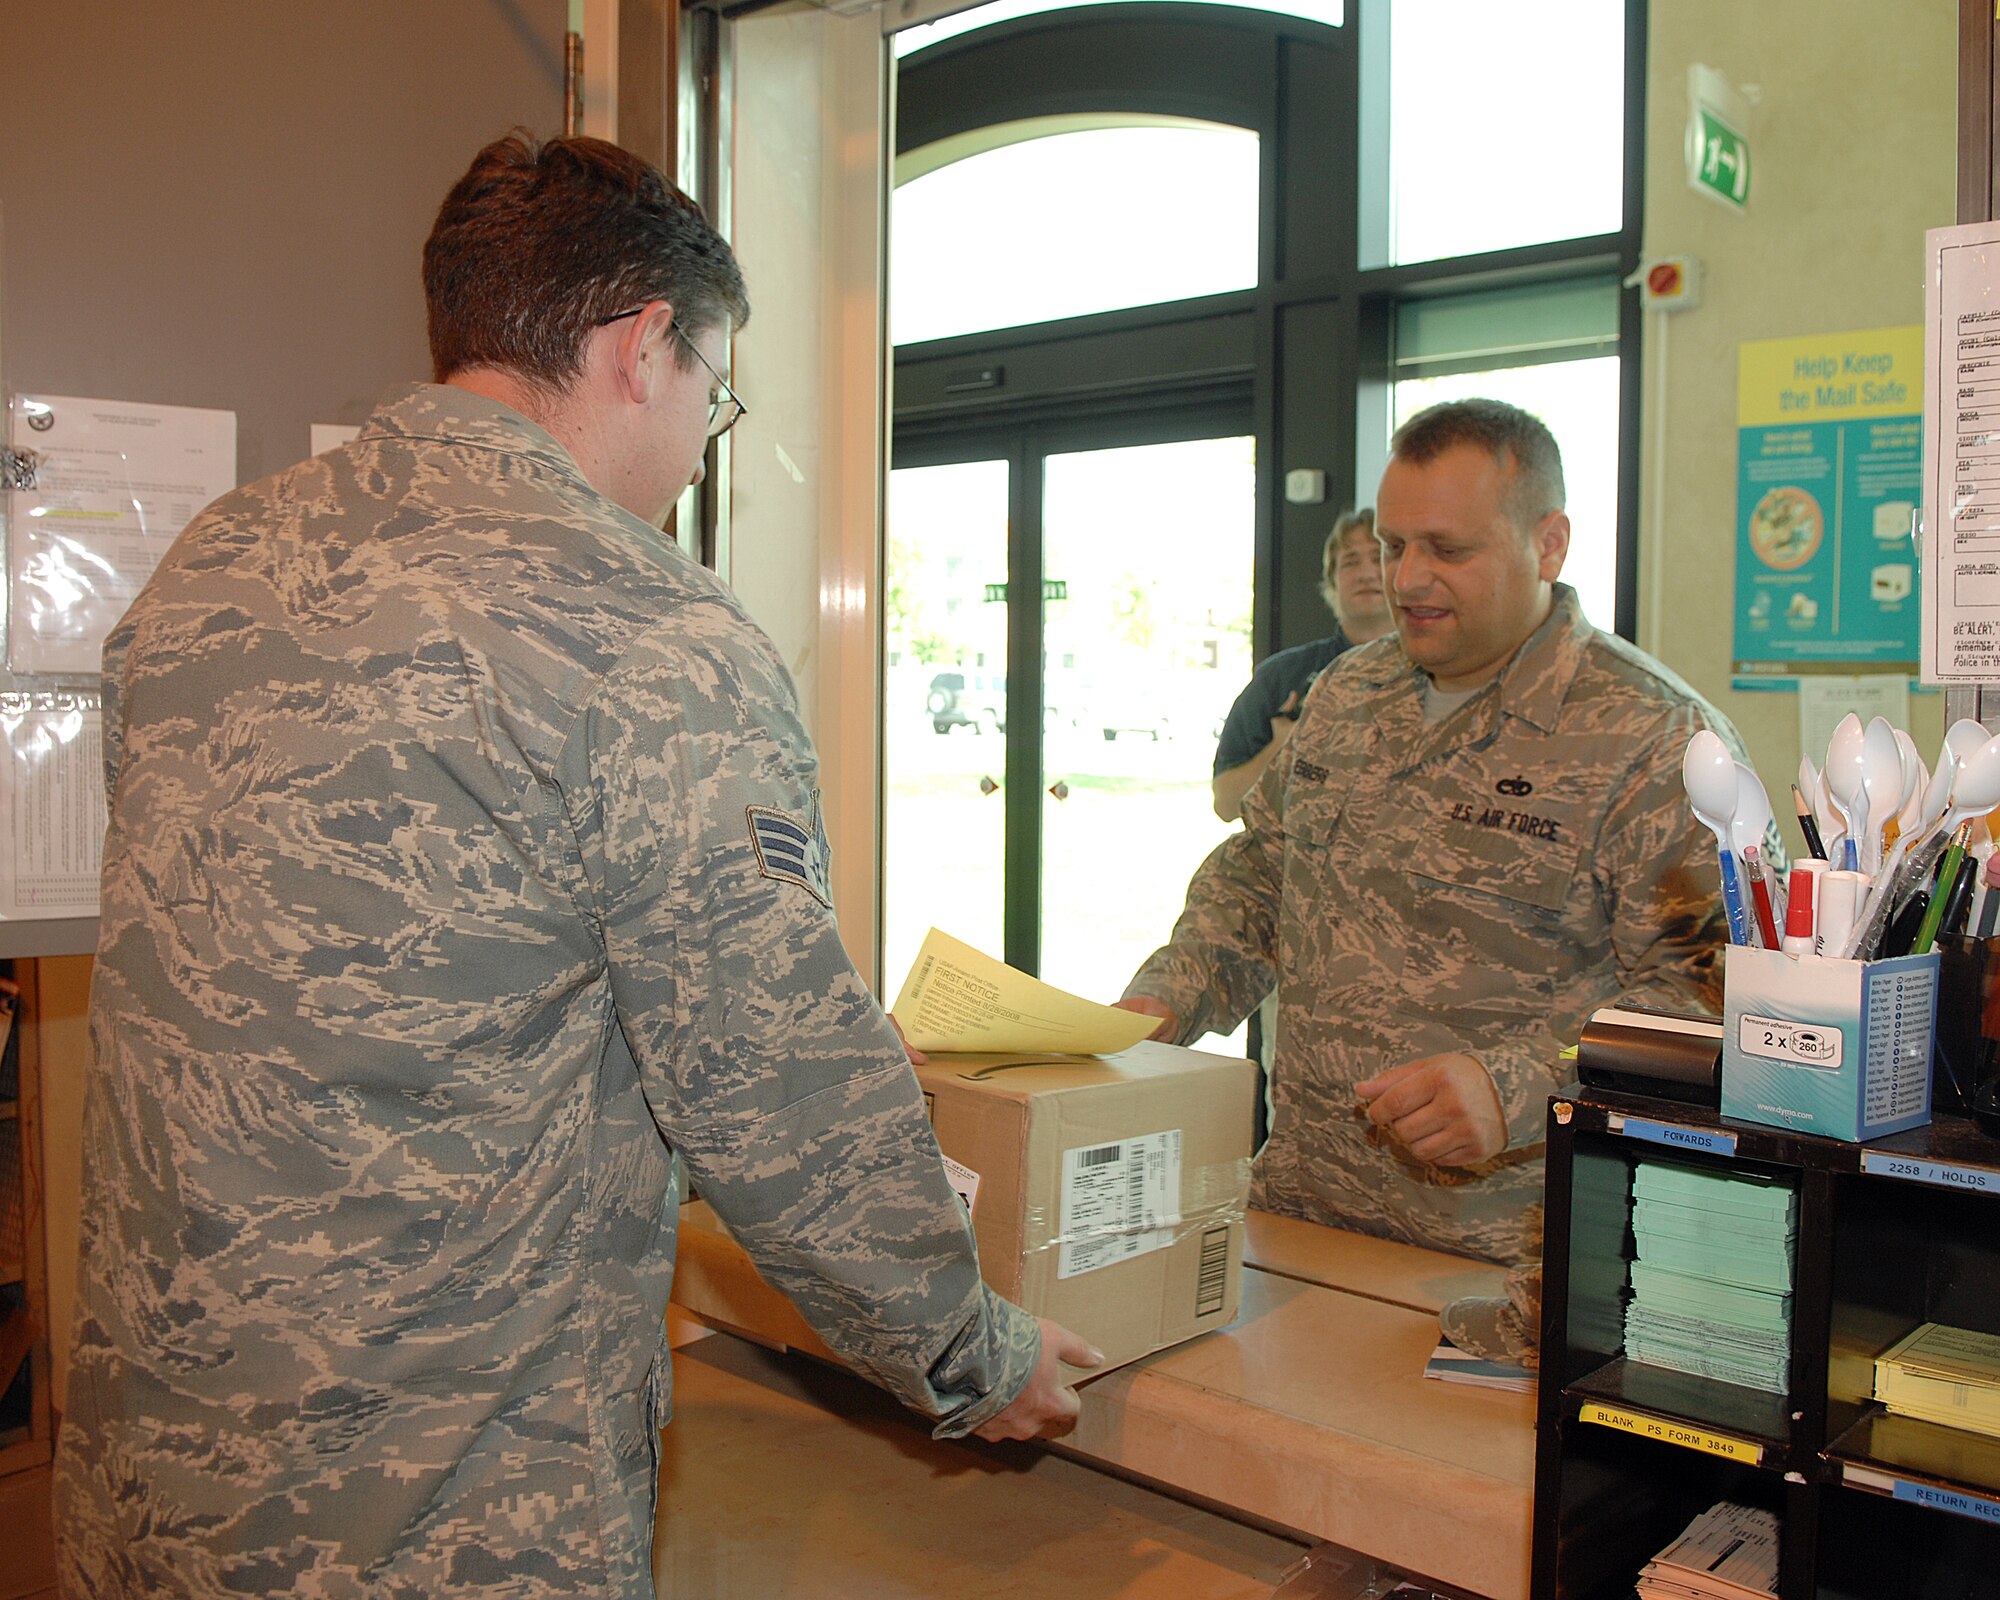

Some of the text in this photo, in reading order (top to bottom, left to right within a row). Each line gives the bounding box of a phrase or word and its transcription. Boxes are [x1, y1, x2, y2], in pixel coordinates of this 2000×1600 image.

[1794, 352, 1893, 379] Help Keep
[1779, 380, 1907, 412] the Mail Safe
[1953, 626, 1996, 636] BE ALERT,
[1954, 644, 1995, 652] remember
[1953, 659, 1978, 667] Police
[1982, 659, 1990, 667] in
[1451, 803, 1561, 842] U.S. AIR FORCE
[934, 966, 1000, 1003] FIRST NOTICE
[933, 979, 1021, 1021] Notice Printed 8/28/2008
[1744, 1017, 1793, 1030] Permanent adhesive
[1763, 1031, 1817, 1053] 2 x 260
[1757, 1103, 1814, 1120] www.dymo.com
[1889, 1162, 1986, 1186] 2258 / HOLDS
[1596, 1411, 1735, 1455] BLANK PS FORM 3849
[1915, 1488, 1968, 1510] RETURN
